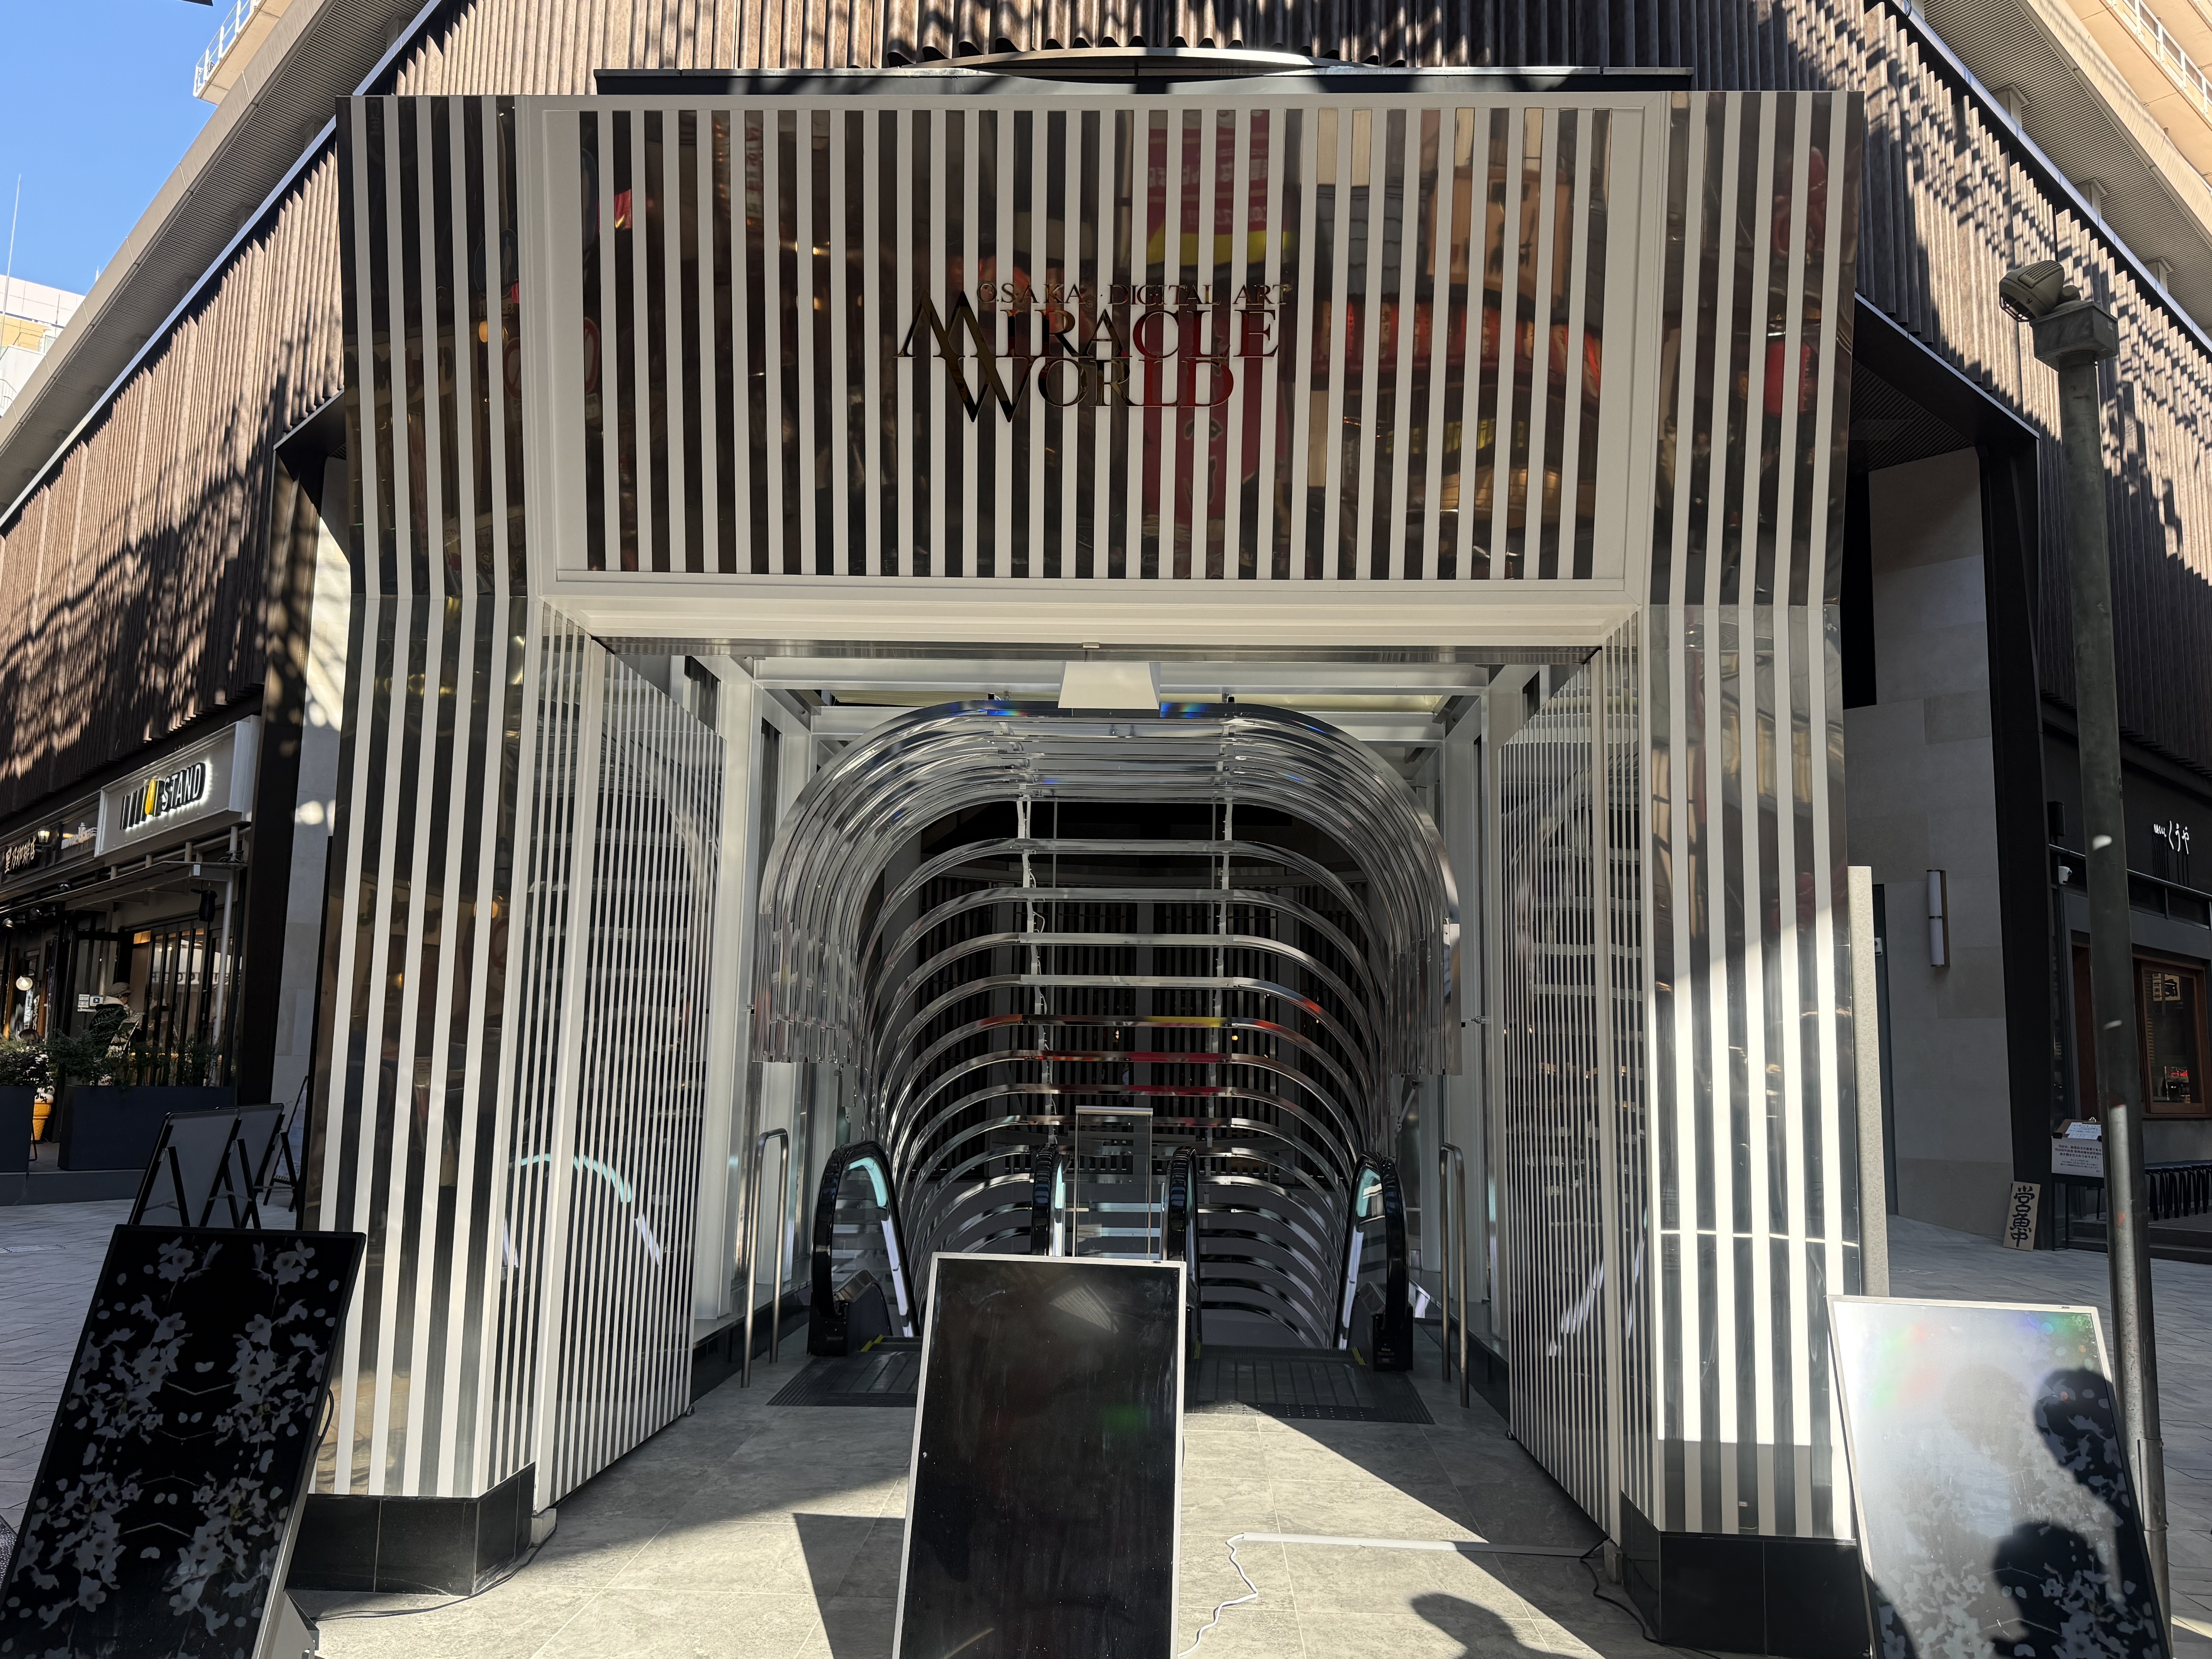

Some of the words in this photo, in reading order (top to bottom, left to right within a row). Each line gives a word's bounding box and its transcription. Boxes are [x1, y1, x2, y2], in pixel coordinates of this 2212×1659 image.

[893, 290, 1279, 359] MIRACLE
[977, 283, 1086, 304] OSAKA
[1108, 284, 1221, 305] DIGITAL
[1232, 284, 1291, 305] ART
[933, 355, 1234, 422] WORLD
